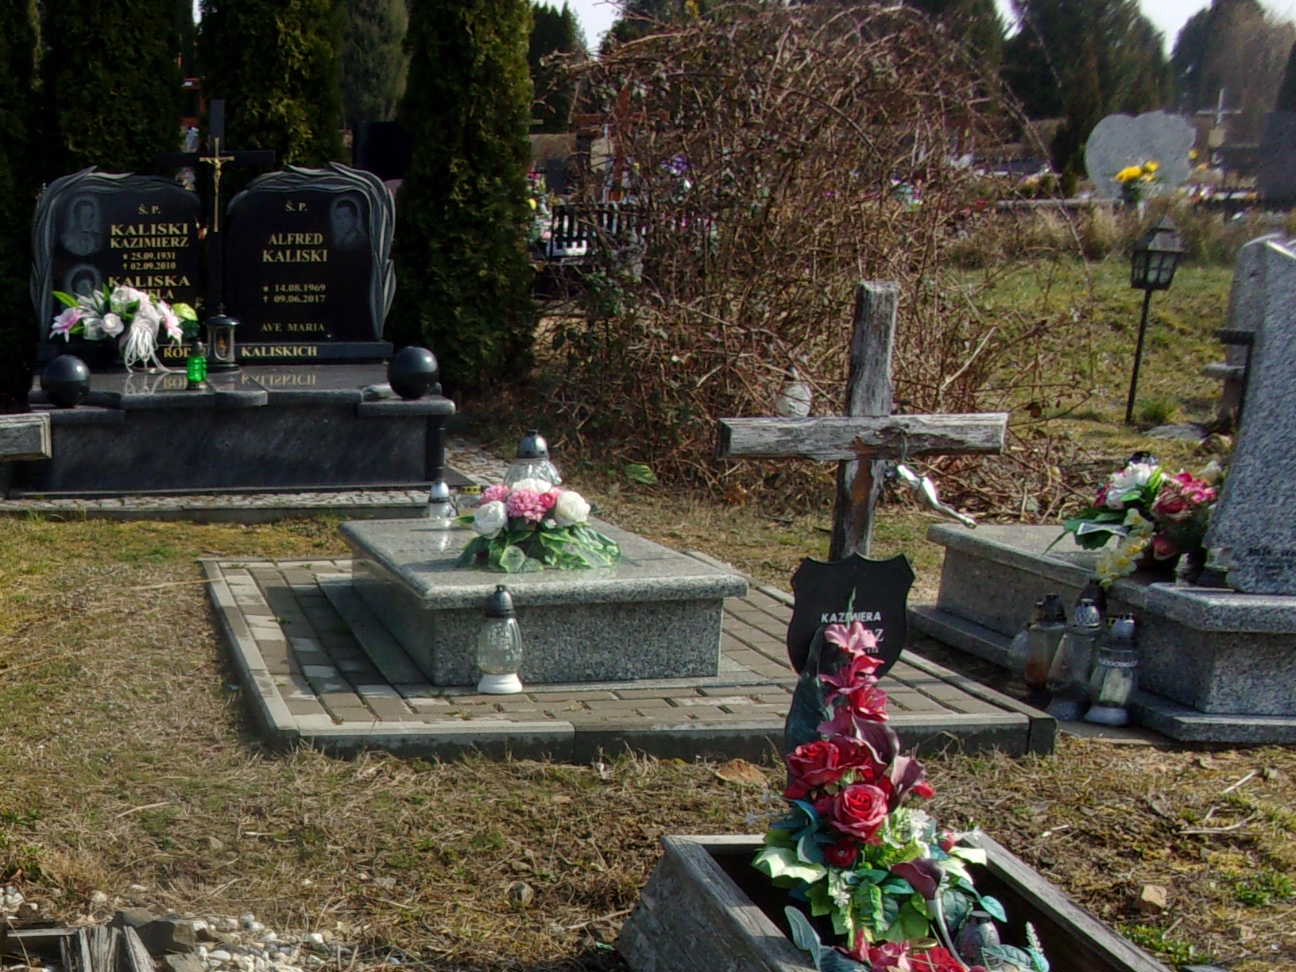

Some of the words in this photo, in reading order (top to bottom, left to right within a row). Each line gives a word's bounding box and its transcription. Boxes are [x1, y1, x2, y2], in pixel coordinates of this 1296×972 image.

[110, 223, 190, 236] KALISKI
[110, 237, 190, 249] KAZIMIERZ
[268, 232, 324, 246] ALFRED
[262, 249, 329, 263] KALISKI
[107, 274, 191, 288] KALISKA
[261, 322, 282, 333] AVE
[287, 322, 326, 333] MARIA
[241, 346, 318, 358] KALISKICH
